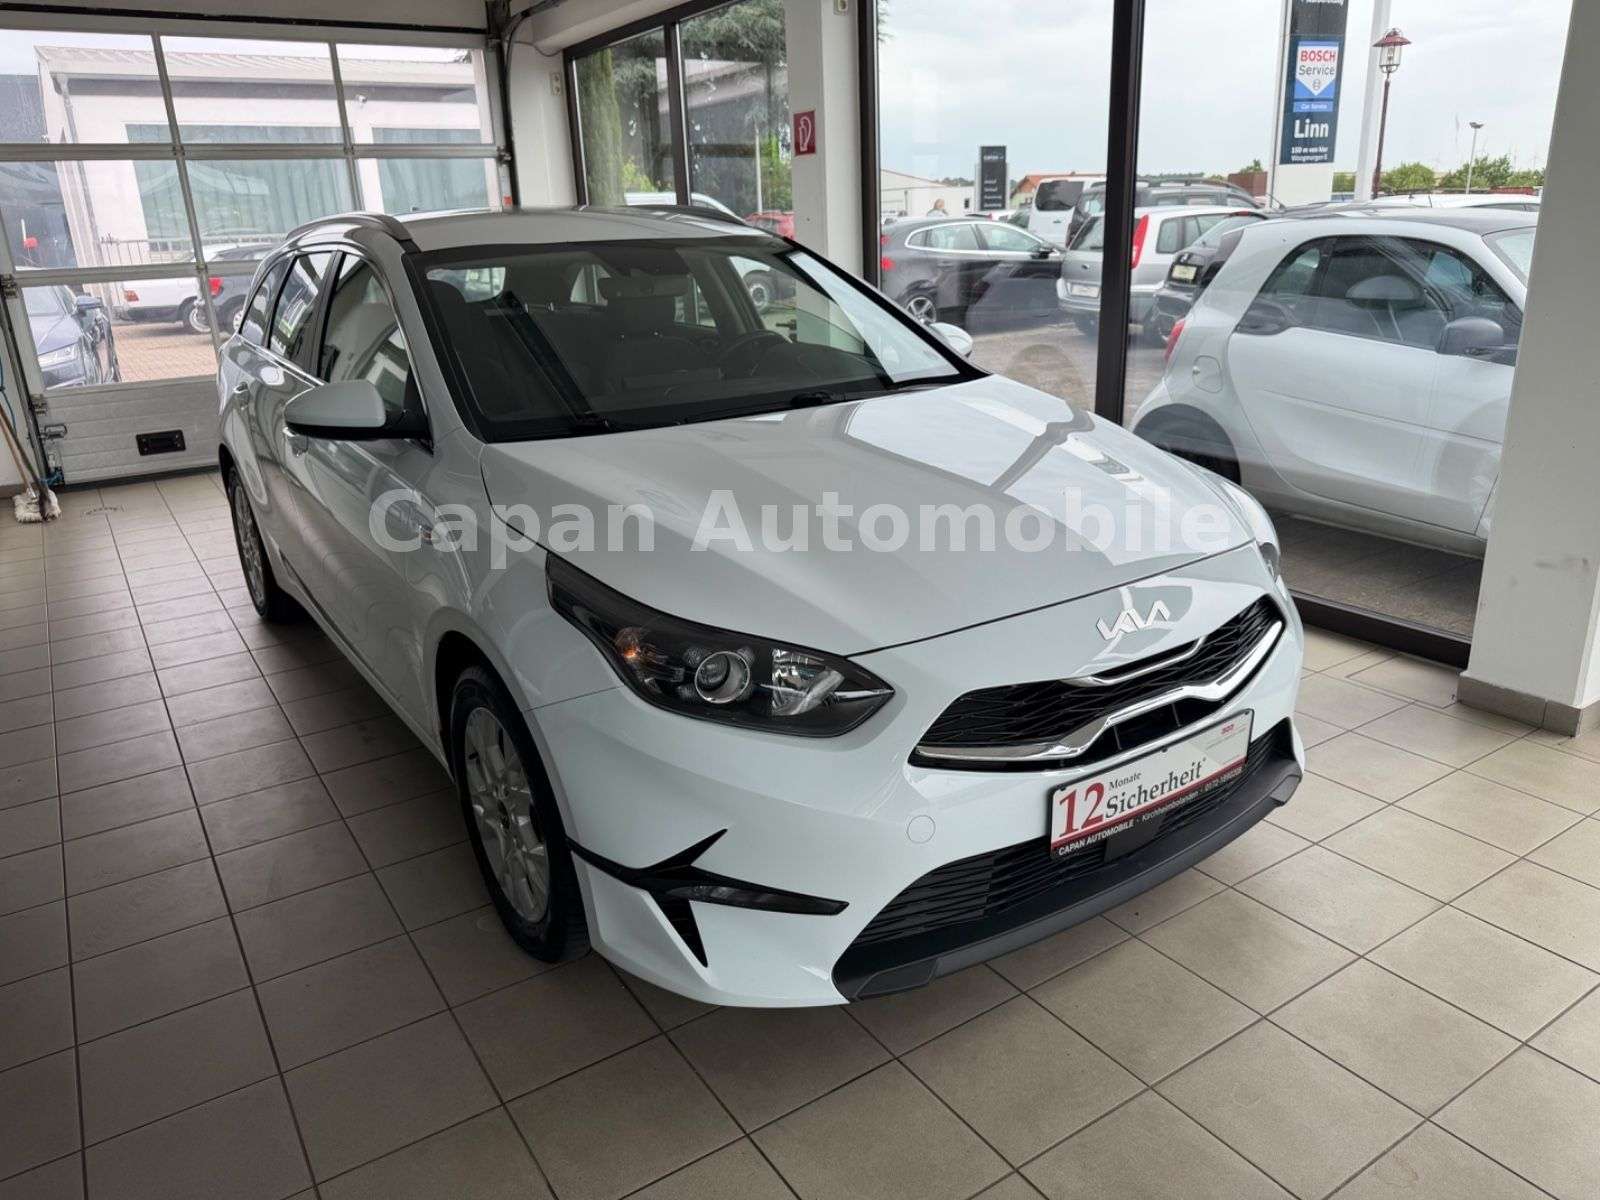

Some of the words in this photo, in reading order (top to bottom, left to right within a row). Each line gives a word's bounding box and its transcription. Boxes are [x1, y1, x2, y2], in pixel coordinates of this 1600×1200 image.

[1300, 50, 1336, 62] BOSCH
[1298, 65, 1335, 76] Service
[1293, 119, 1329, 139] Linn
[1108, 771, 1142, 792] Monate
[1058, 780, 1105, 838] 12
[1058, 839, 1087, 856] CAPAN
[1086, 818, 1134, 846] AUTOMOBILE
